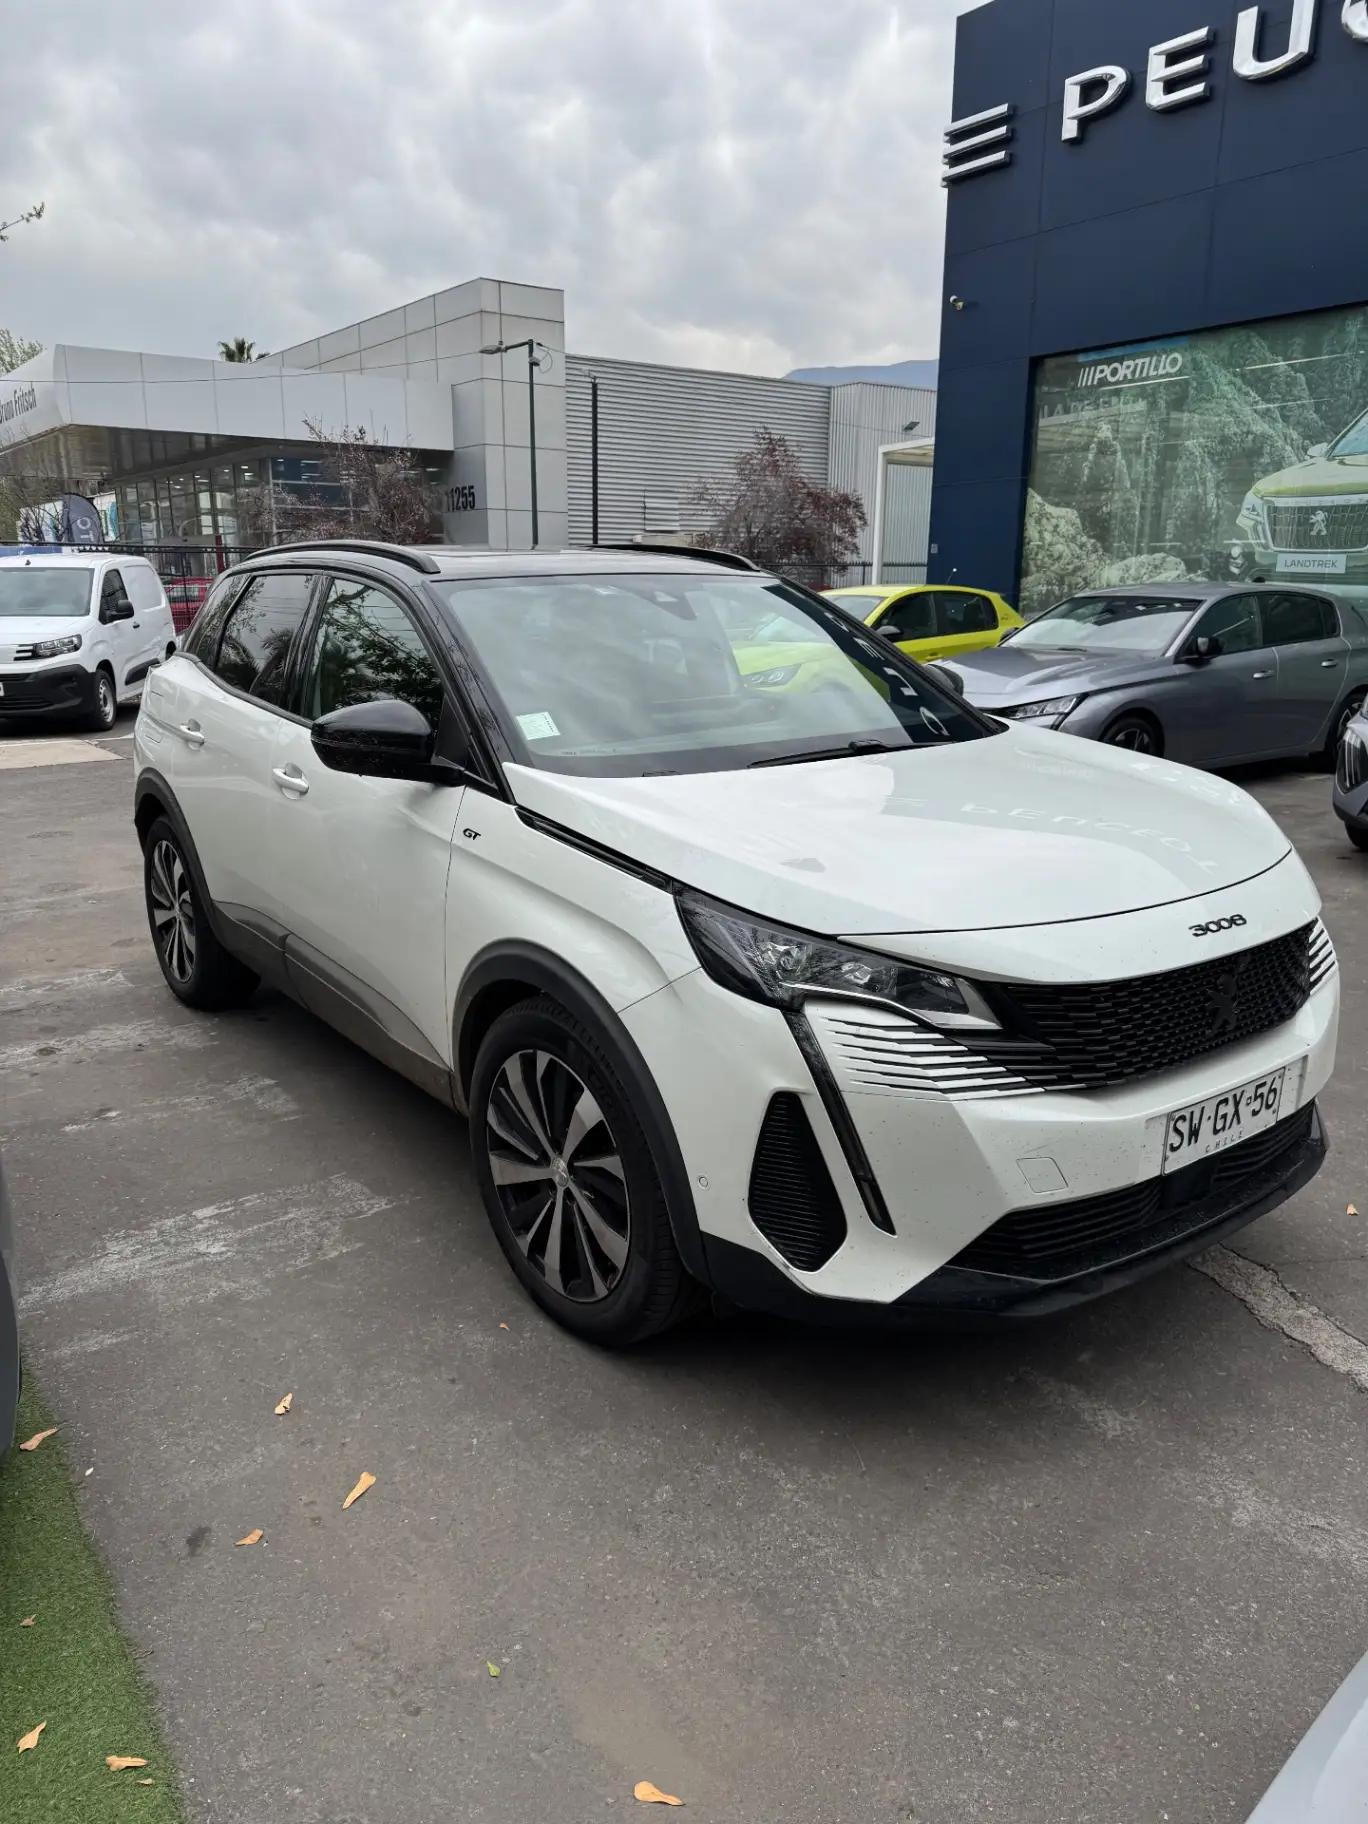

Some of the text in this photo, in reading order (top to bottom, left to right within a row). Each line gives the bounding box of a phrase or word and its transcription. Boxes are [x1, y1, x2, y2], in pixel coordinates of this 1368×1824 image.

[1094, 352, 1183, 385] PORTILLO
[1284, 559, 1338, 569] LANDTREK
[463, 828, 482, 840] GT
[1188, 914, 1247, 937] 3008
[1205, 1131, 1244, 1153] CHILE
